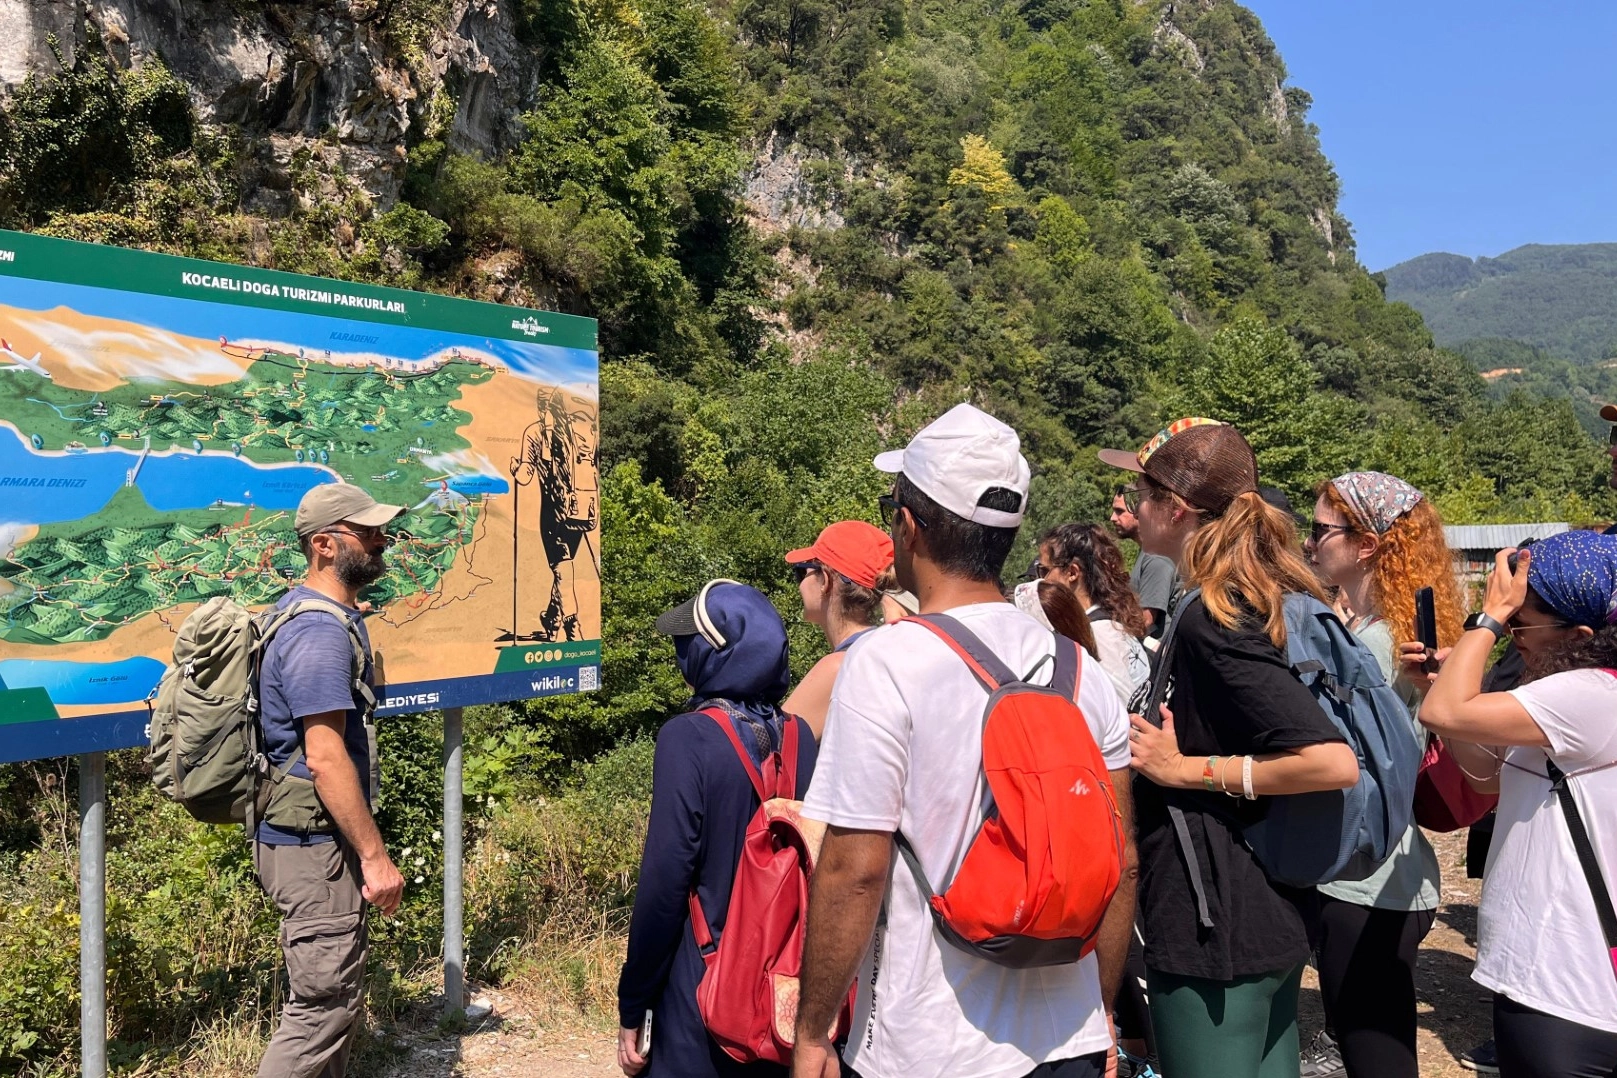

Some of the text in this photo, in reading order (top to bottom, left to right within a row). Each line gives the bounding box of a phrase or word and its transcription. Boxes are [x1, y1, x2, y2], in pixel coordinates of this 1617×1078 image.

[334, 293, 405, 313] PARKURLARI
[531, 675, 574, 692] wikiloc
[866, 1020, 874, 1051] MAKE
[870, 964, 880, 987] DAY
